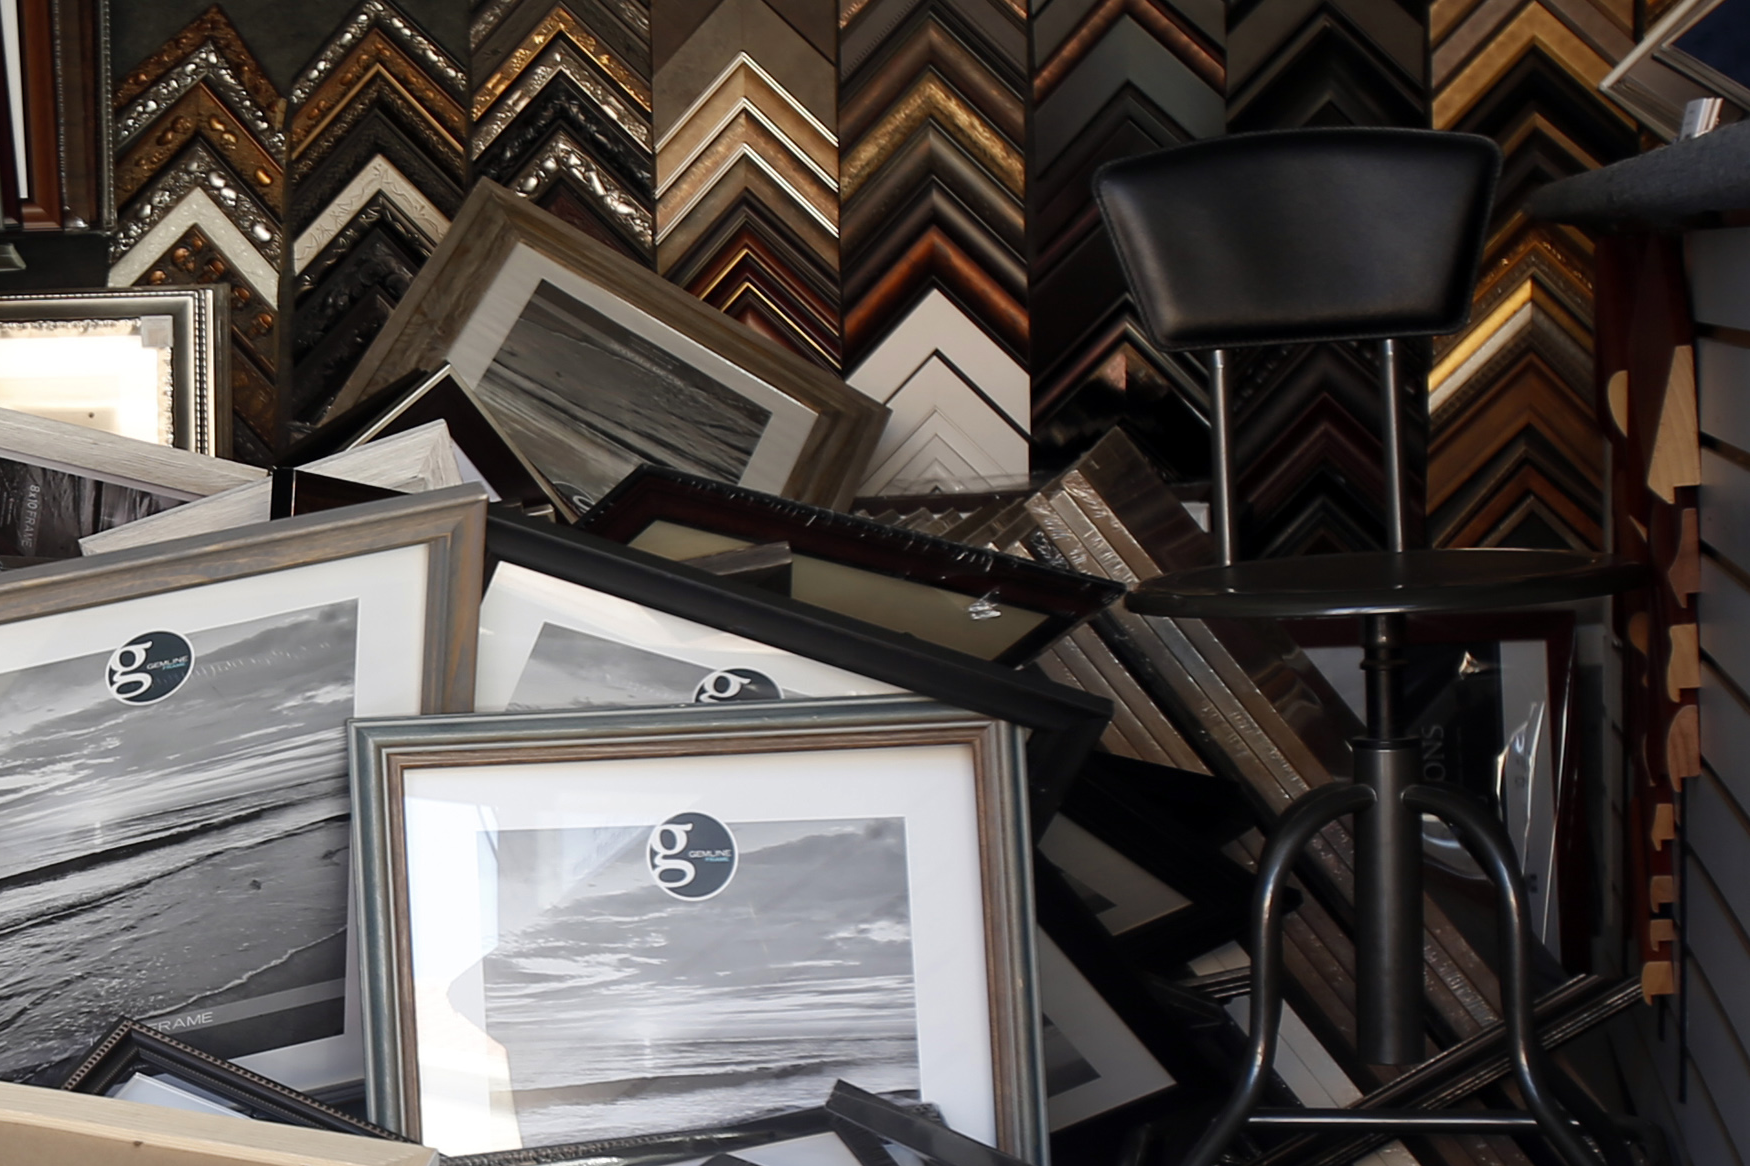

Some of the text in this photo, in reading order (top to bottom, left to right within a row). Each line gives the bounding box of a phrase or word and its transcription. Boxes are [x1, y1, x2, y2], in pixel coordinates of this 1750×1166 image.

[21, 484, 41, 548] 8x10 FRAME
[110, 641, 152, 699] g
[146, 655, 189, 670] GEMLINE
[650, 823, 696, 888] g
[689, 849, 732, 858] GEMLINE
[148, 1012, 213, 1032] FRAME
